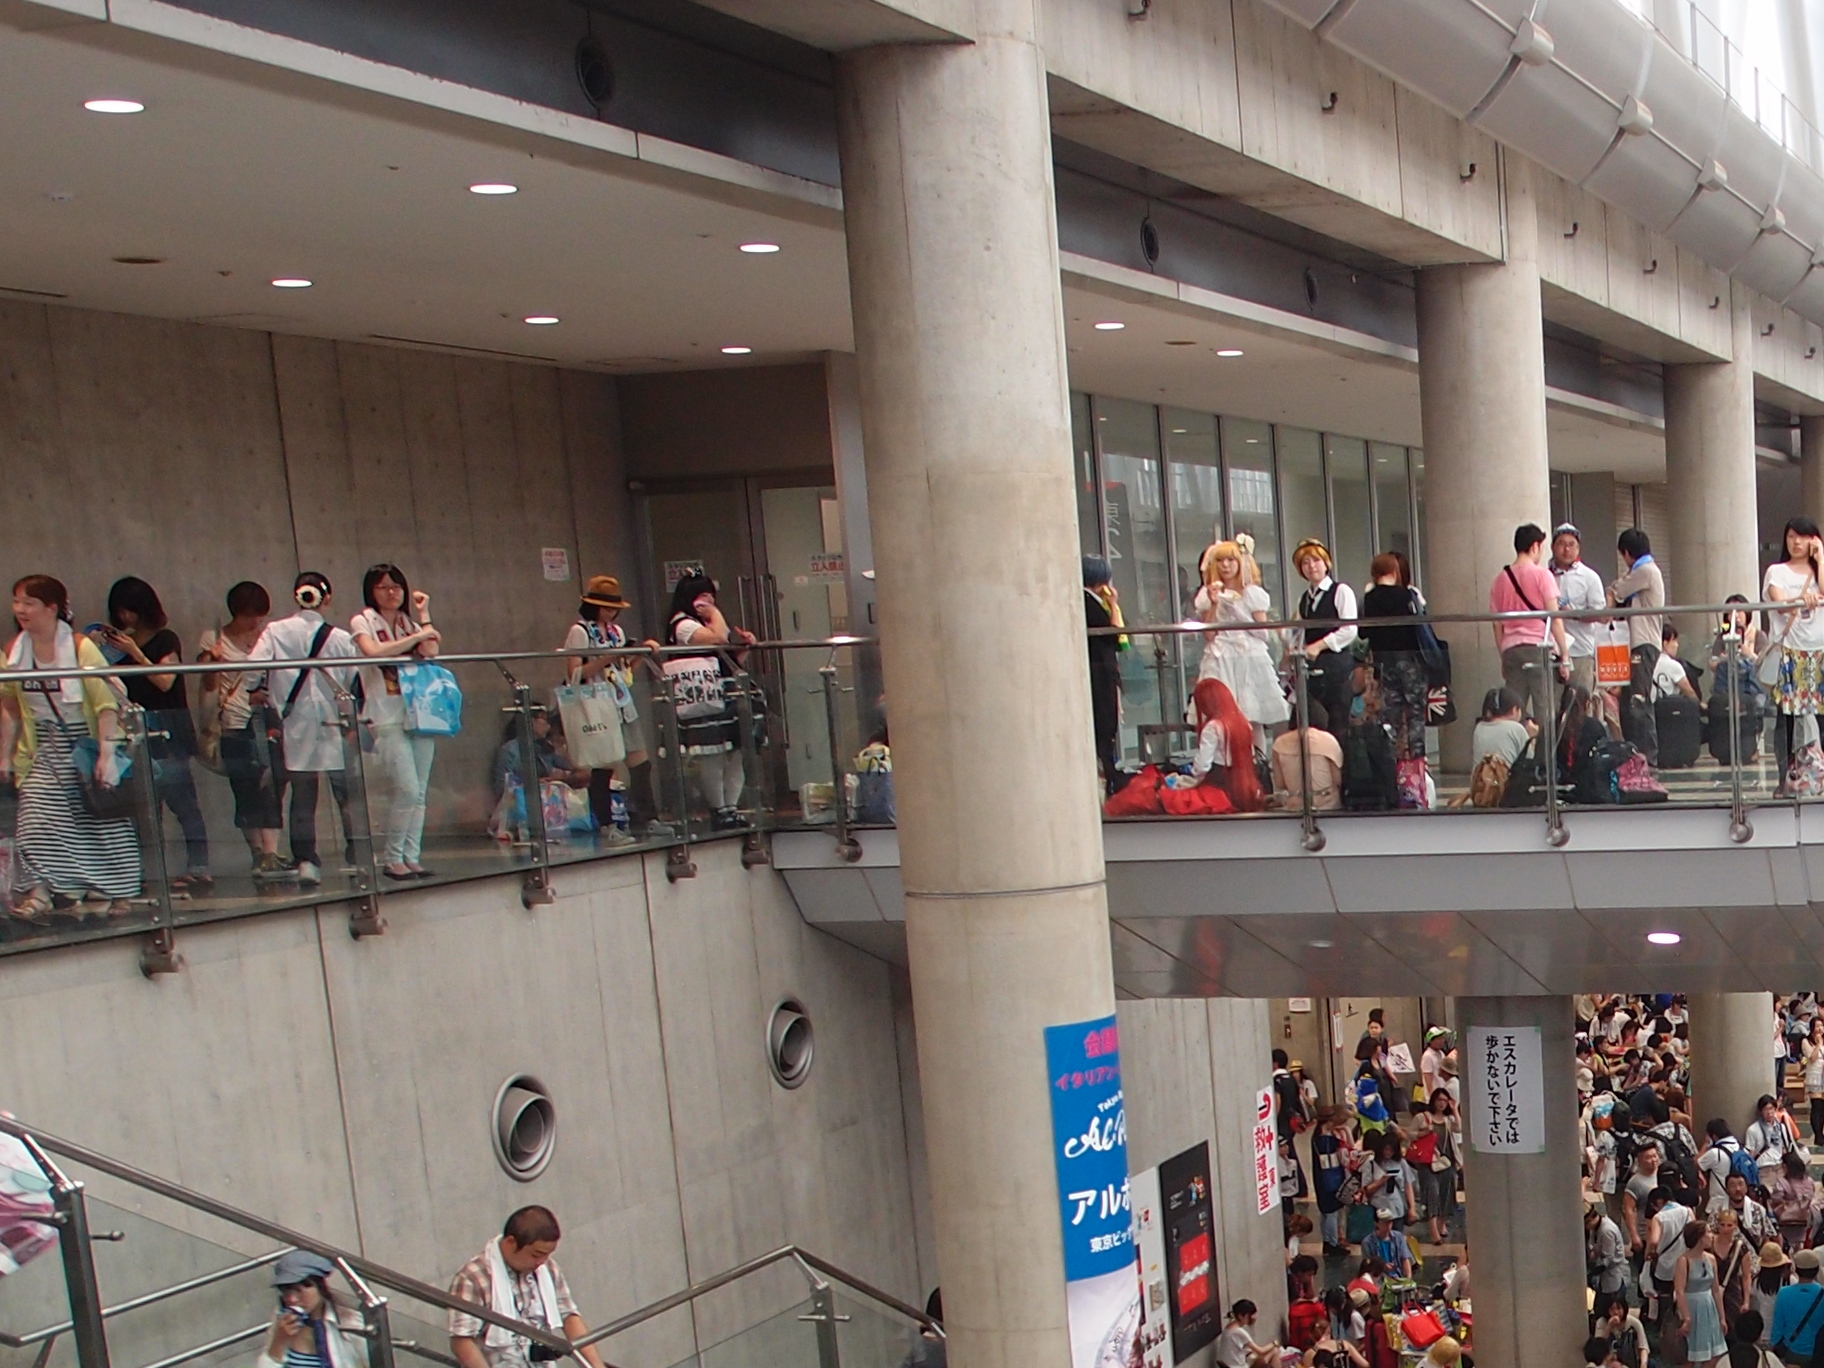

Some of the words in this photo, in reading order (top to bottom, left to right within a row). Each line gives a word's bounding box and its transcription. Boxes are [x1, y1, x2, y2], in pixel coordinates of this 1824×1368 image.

[1485, 1035, 1502, 1147] 歩かないで下さい
[1503, 1035, 1519, 1144] エスカレータでは
